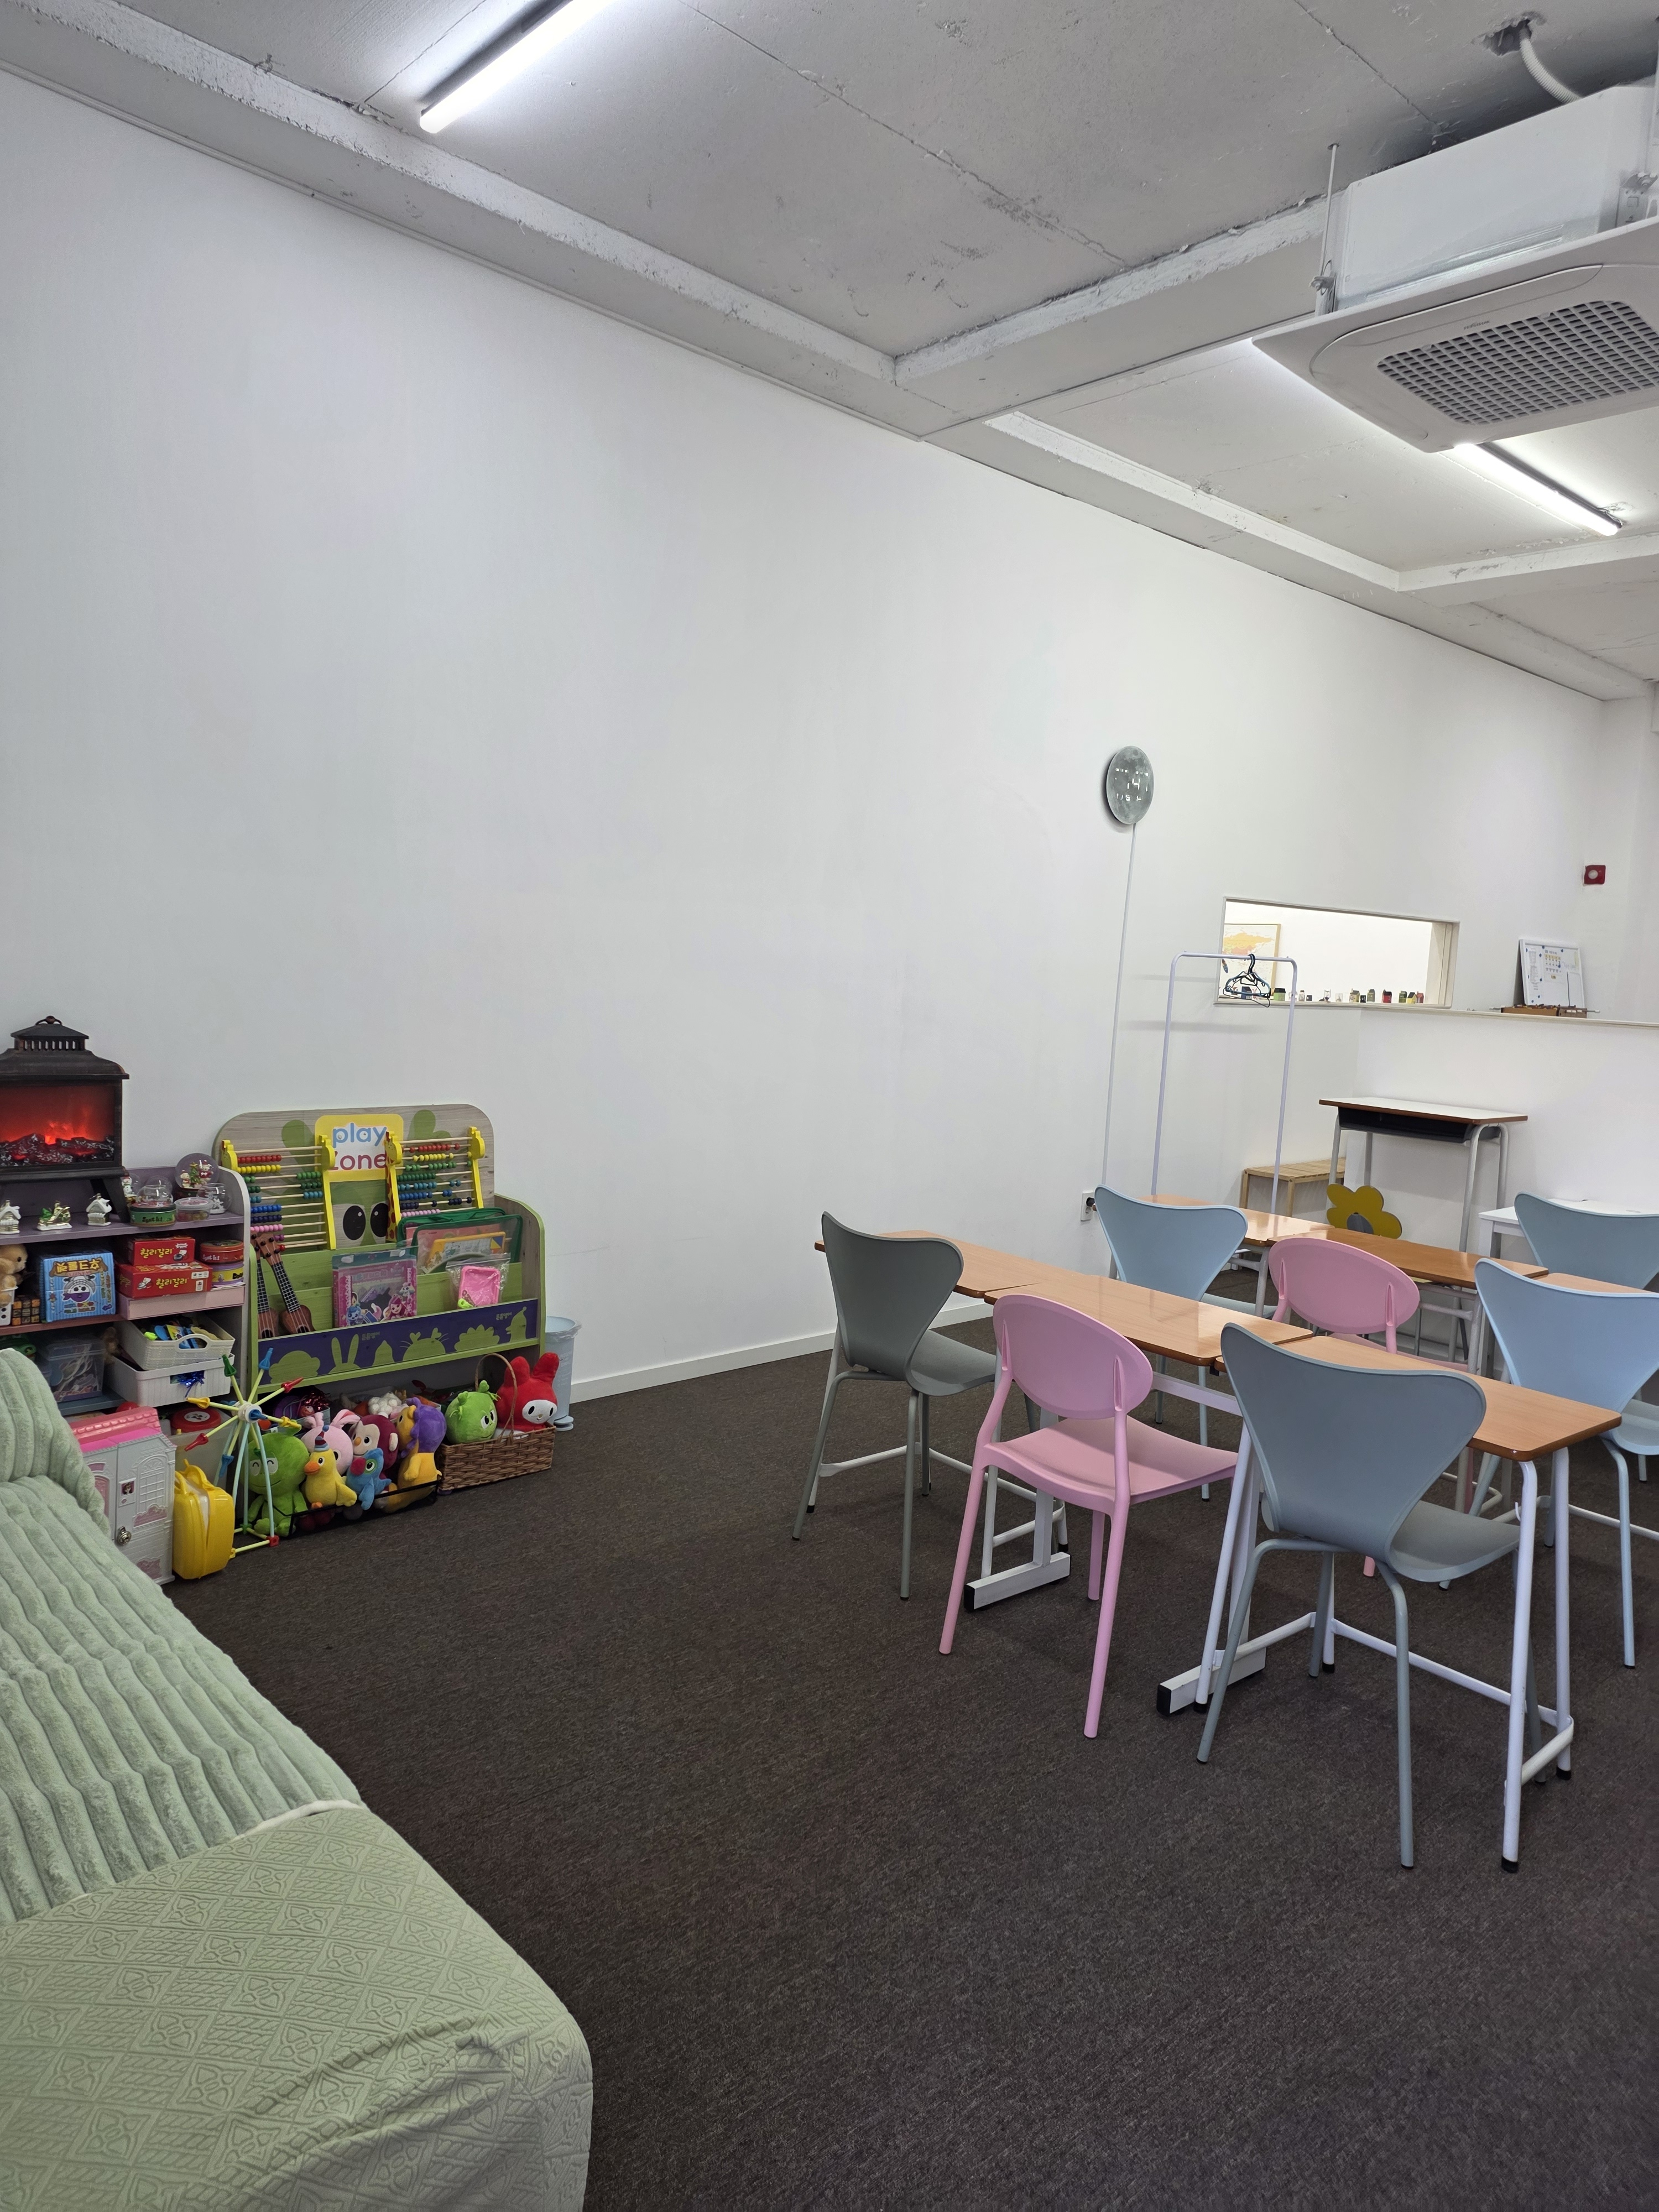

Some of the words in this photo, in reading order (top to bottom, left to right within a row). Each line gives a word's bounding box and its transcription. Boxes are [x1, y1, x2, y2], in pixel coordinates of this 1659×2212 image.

[333, 1123, 387, 1149] play
[140, 1248, 173, 1259] 할리갈리
[155, 1278, 187, 1289] 할리갈리
